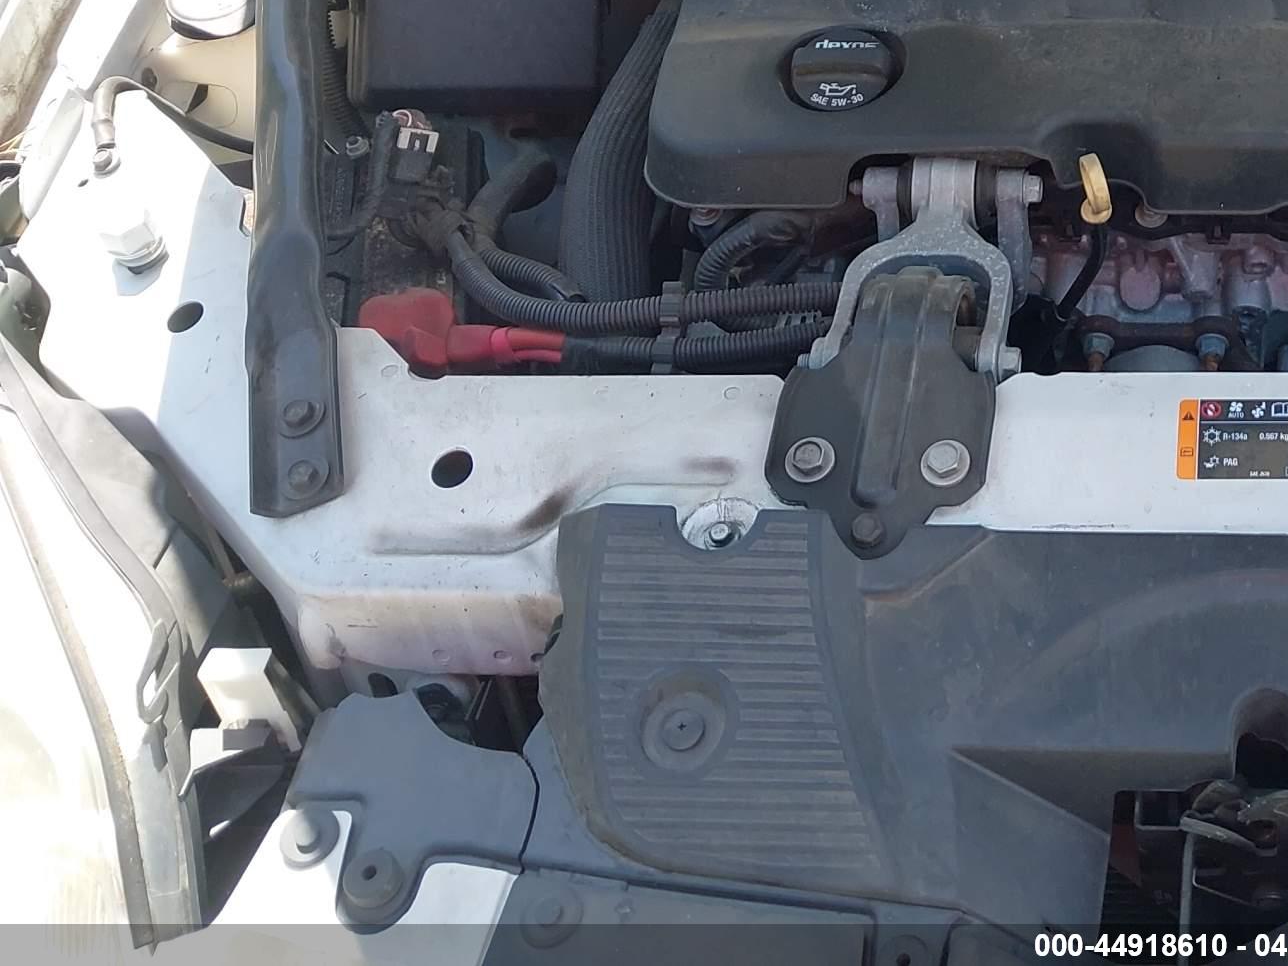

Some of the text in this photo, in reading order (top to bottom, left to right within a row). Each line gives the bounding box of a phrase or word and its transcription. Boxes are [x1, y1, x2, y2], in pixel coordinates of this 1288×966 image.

[810, 93, 864, 106] SAE 5W-30
[1222, 432, 1248, 440] R-134a
[1280, 432, 1288, 442] kg
[1223, 458, 1238, 466] PAG
